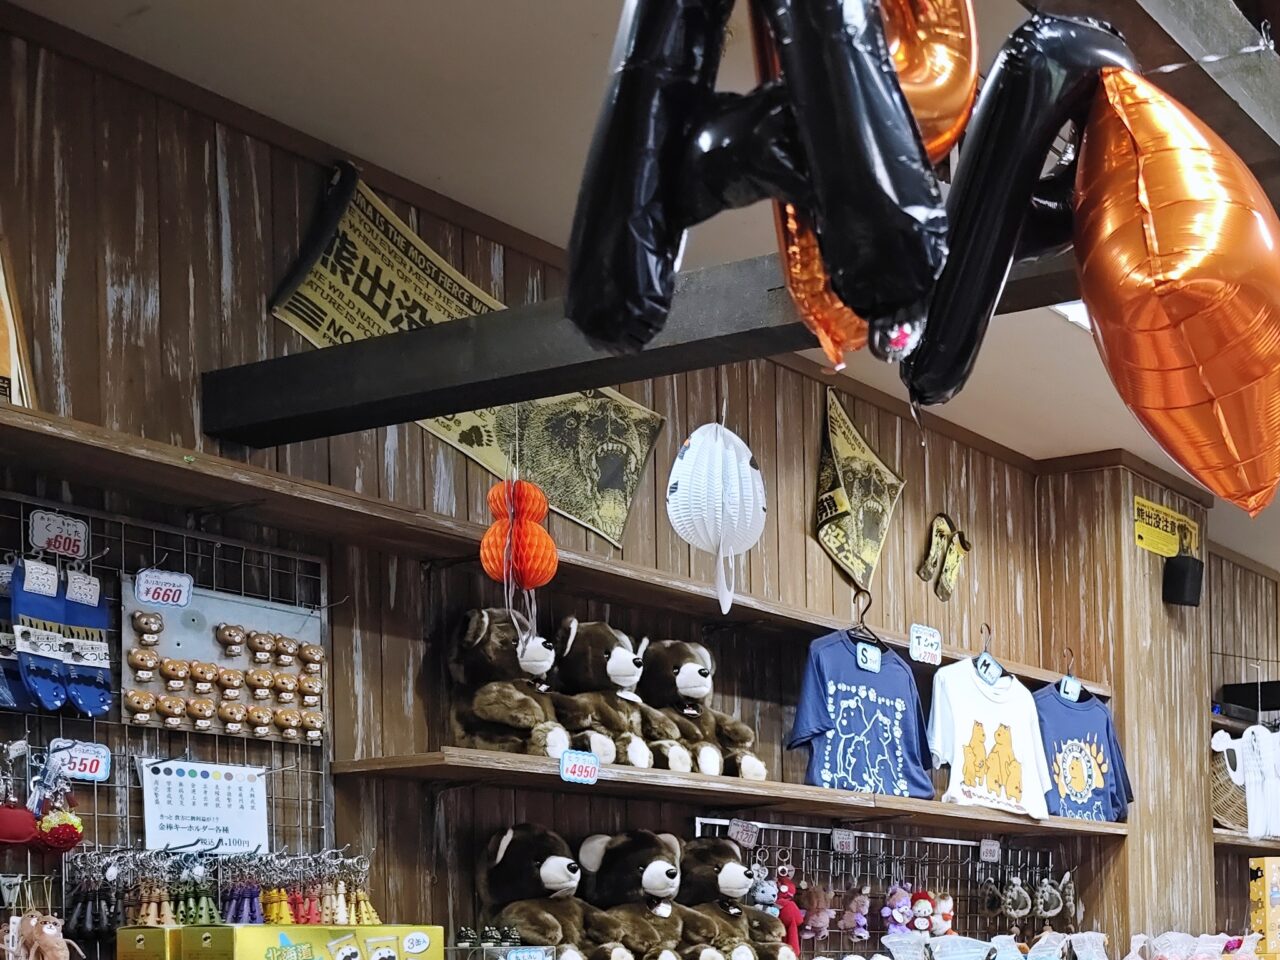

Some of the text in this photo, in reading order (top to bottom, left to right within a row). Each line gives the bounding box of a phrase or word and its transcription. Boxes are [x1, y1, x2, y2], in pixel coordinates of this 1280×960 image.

[349, 221, 437, 302] WHISPER OF THE
[357, 217, 453, 304] YOU EVER MET THE
[375, 212, 470, 306] IS THE MOST FIERCE
[328, 281, 355, 309] WILD
[344, 312, 355, 325] IS
[1136, 506, 1177, 536] 熊出没注意
[45, 535, 82, 554] ¥605
[144, 587, 182, 603] ¥660
[861, 648, 868, 664] S
[980, 660, 991, 673] M
[1063, 681, 1070, 695] L
[565, 762, 597, 780] ¥4950
